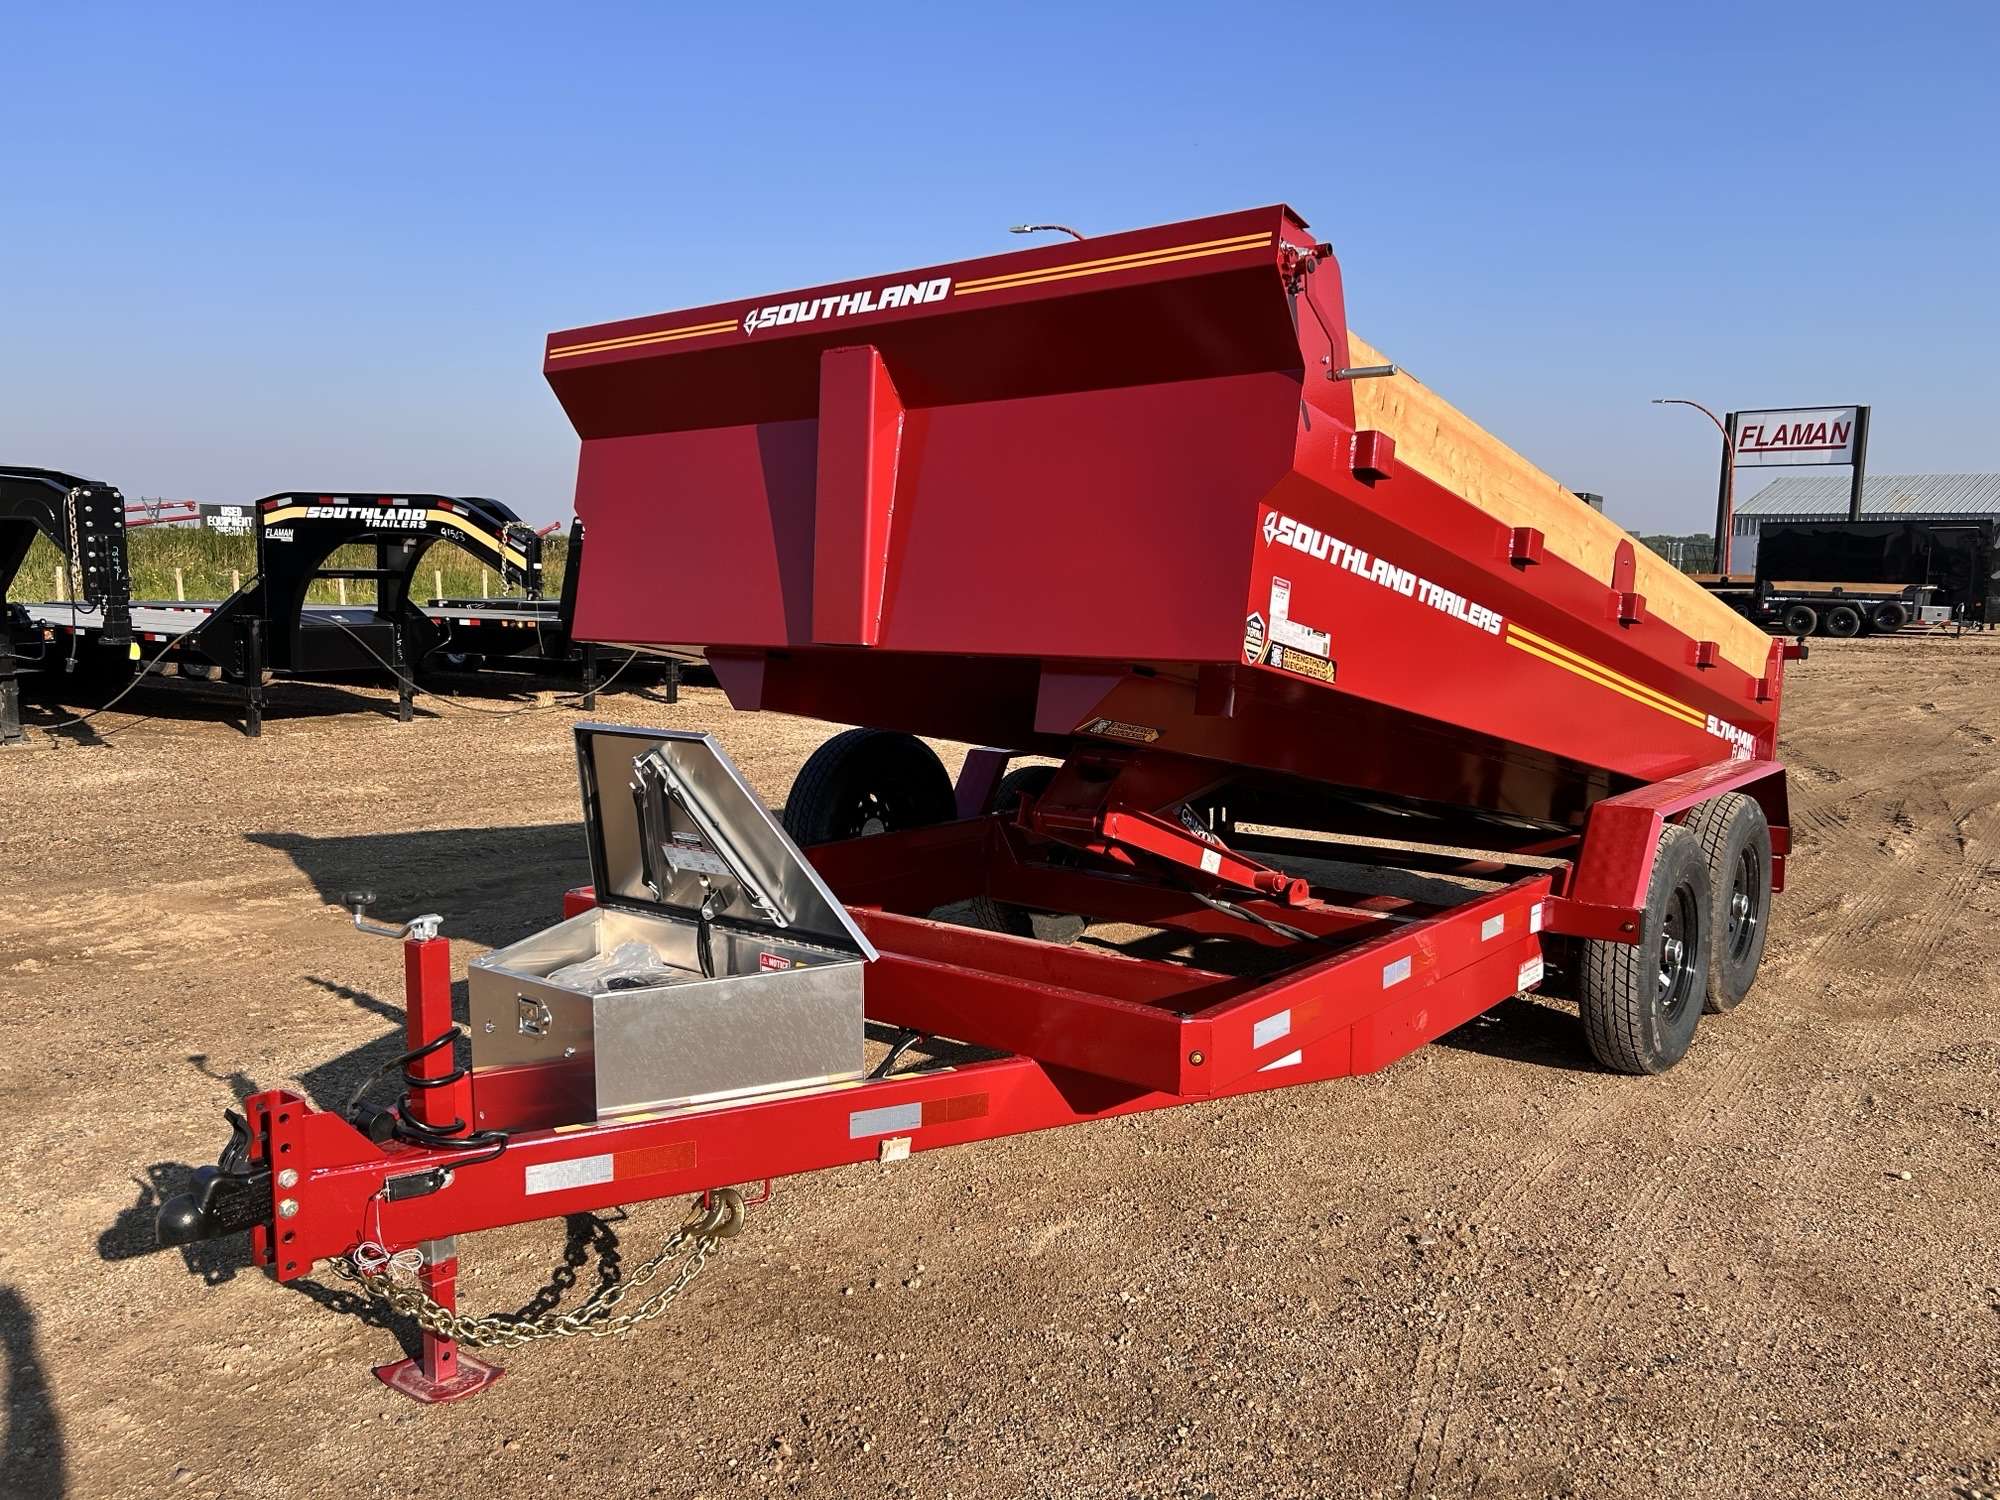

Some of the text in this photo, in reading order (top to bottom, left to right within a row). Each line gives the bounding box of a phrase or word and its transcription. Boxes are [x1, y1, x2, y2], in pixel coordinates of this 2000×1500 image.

[757, 277, 951, 329] SOUTHLAND
[1739, 421, 1852, 448] FLAMAN
[221, 506, 243, 517] USED
[306, 506, 427, 521] SOUTHLAND
[207, 516, 253, 527] EQUIPMENT
[365, 519, 427, 529] TRAILERS
[265, 528, 294, 538] FLAMAN
[1278, 515, 1417, 598] SOUTHLAND
[1418, 578, 1503, 636] TRAILERS
